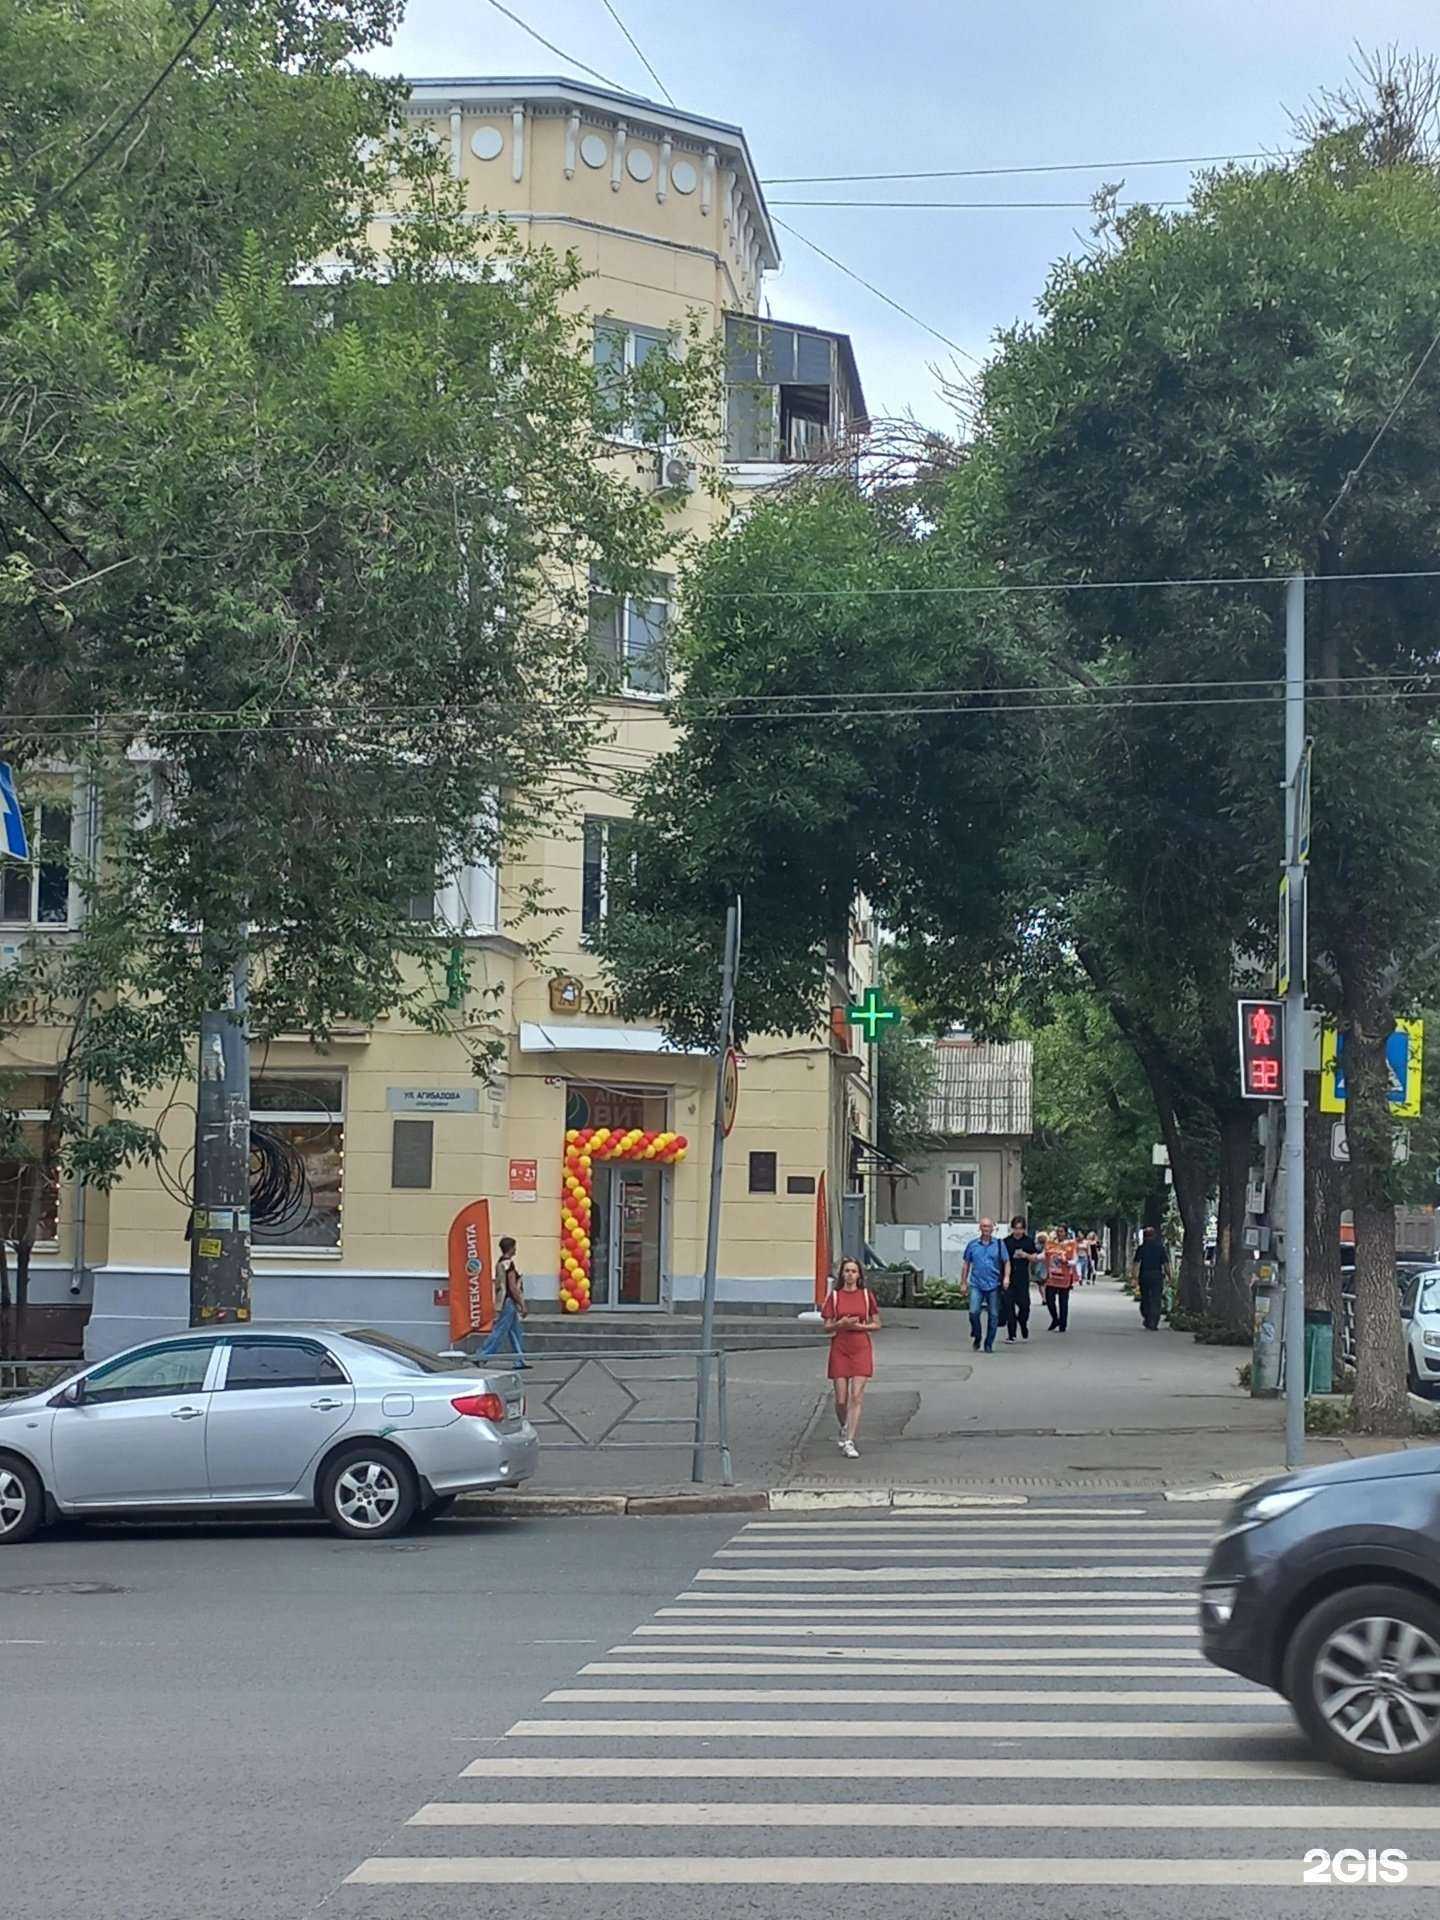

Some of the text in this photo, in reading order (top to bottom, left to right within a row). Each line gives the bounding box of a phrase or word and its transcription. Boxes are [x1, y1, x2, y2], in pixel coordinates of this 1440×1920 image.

[1252, 1060, 1278, 1088] 32
[466, 1223, 481, 1329] АПТЕКА ВИТА
